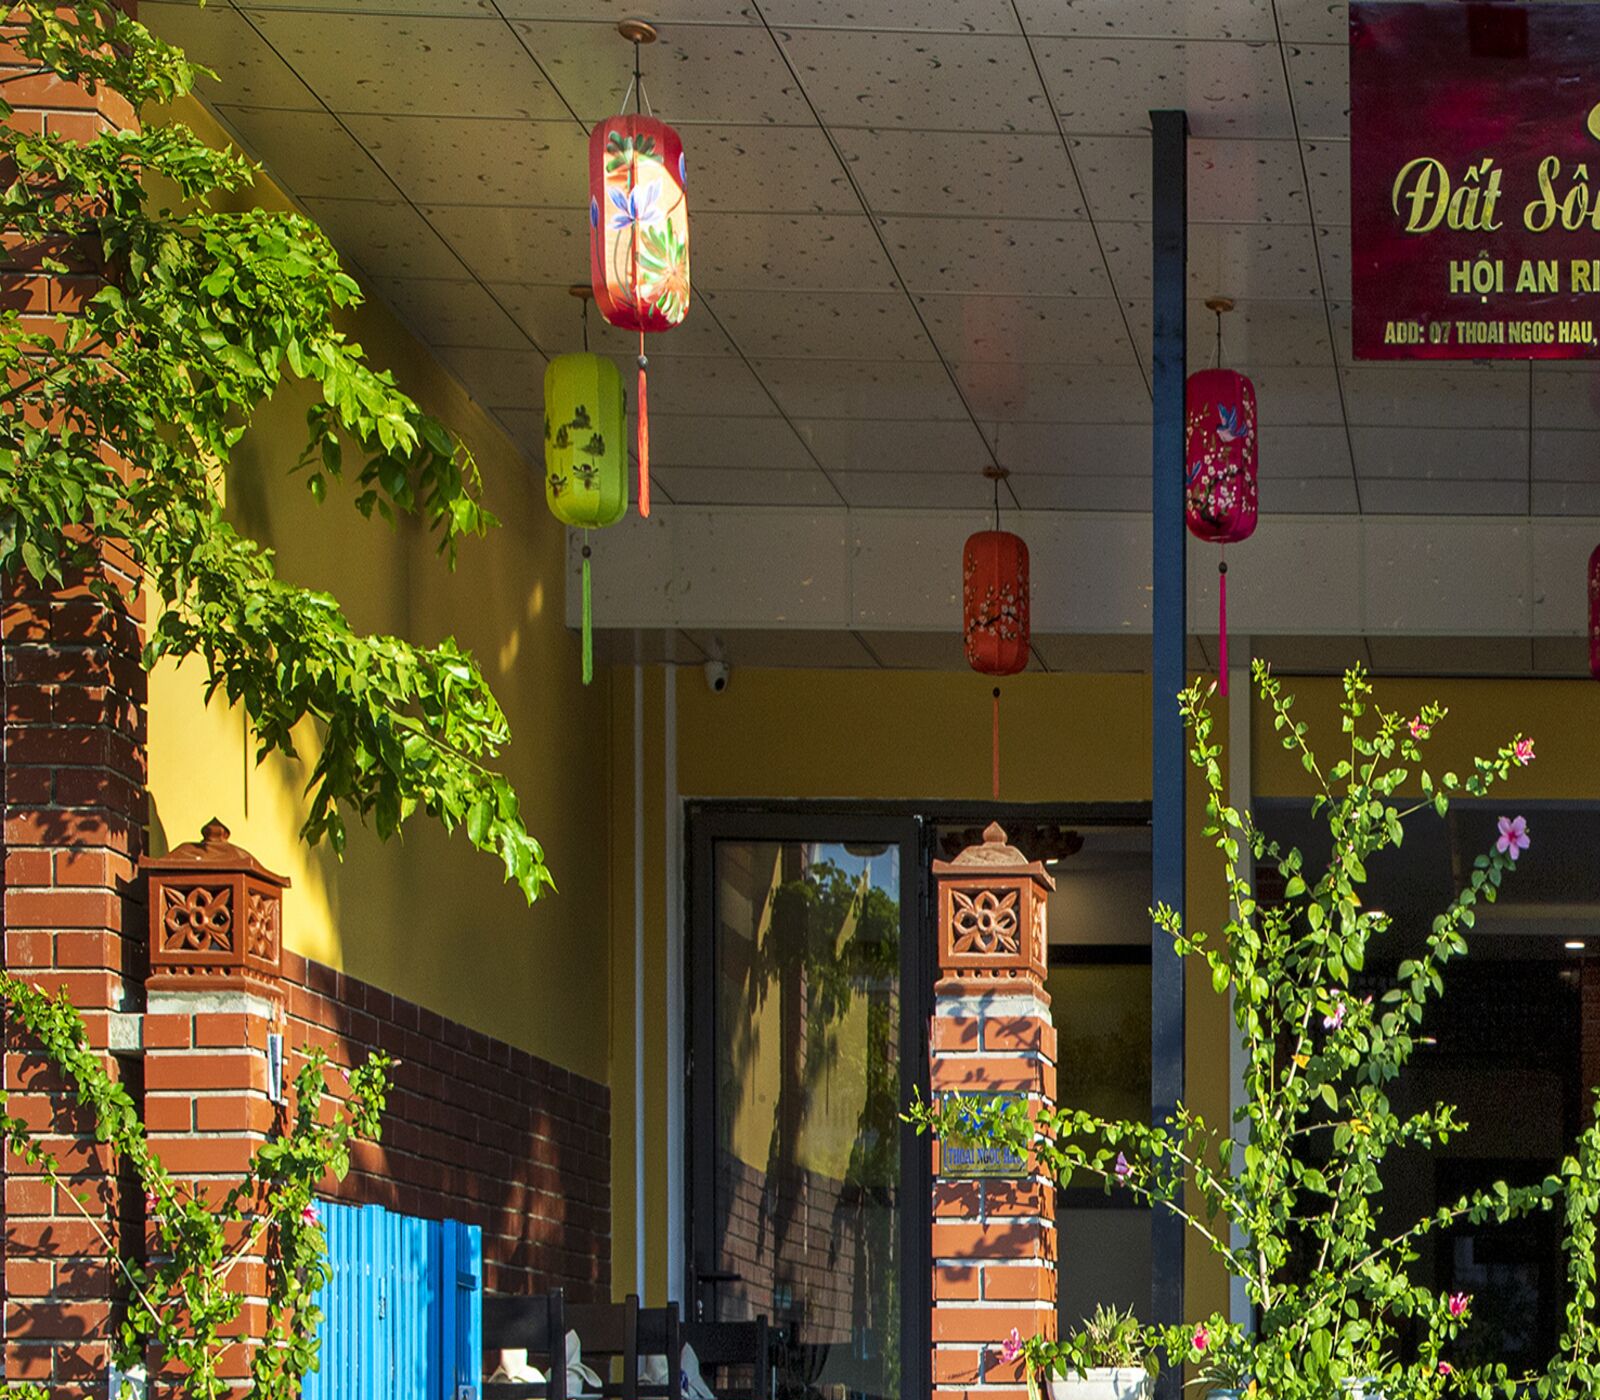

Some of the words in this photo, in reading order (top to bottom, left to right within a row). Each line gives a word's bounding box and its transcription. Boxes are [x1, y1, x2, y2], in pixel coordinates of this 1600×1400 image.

[1392, 157, 1503, 233] Đất
[1449, 249, 1504, 304] HỘI
[1515, 260, 1559, 293] AN
[1384, 321, 1425, 344] ADD:
[1428, 321, 1451, 344] 07
[1456, 321, 1504, 344] THOAI
[1508, 321, 1554, 344] NGOC
[1558, 321, 1598, 346] HAU,
